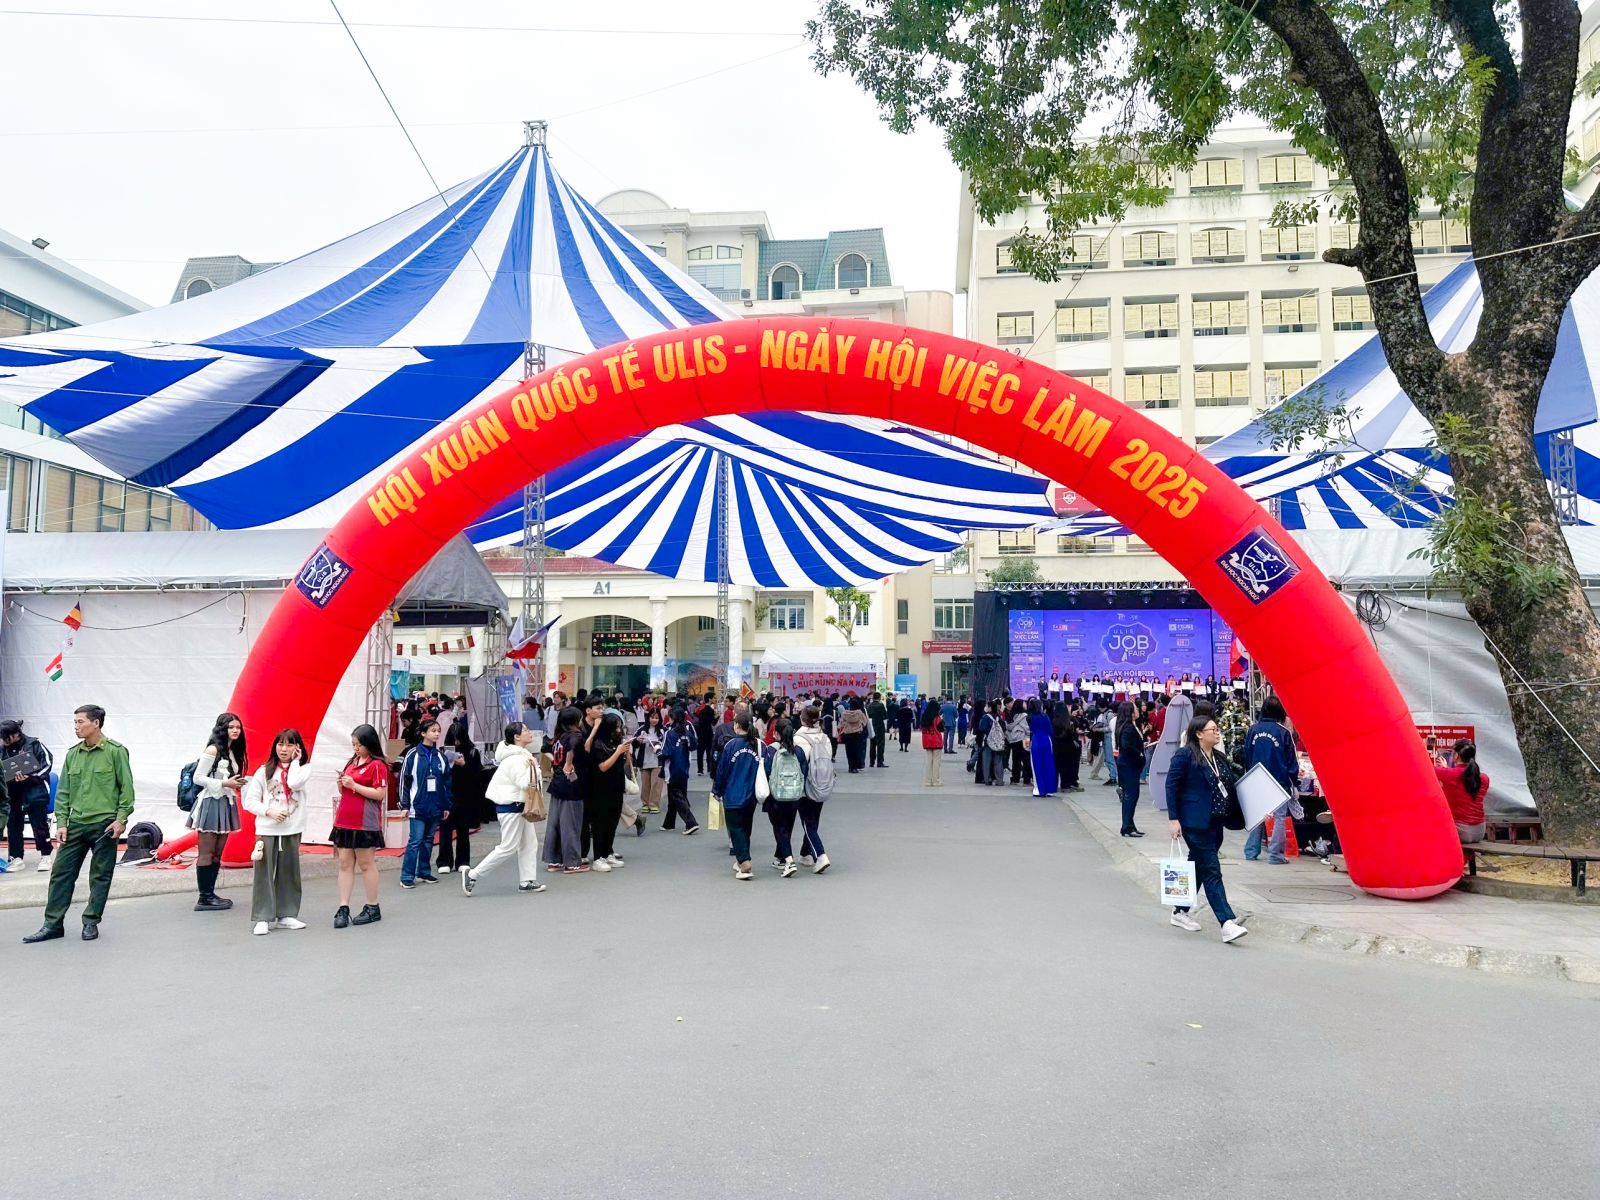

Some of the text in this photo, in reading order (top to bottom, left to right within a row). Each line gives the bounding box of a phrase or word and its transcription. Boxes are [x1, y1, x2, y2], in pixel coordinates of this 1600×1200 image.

[367, 326, 1209, 527] HỘI XUÂN QUỐC TẾ ULIS - NGÀY HỘI VIỆC LÀM 2025
[1248, 562, 1261, 576] ULIS
[592, 581, 611, 595] A1
[1108, 634, 1150, 650] JOB
